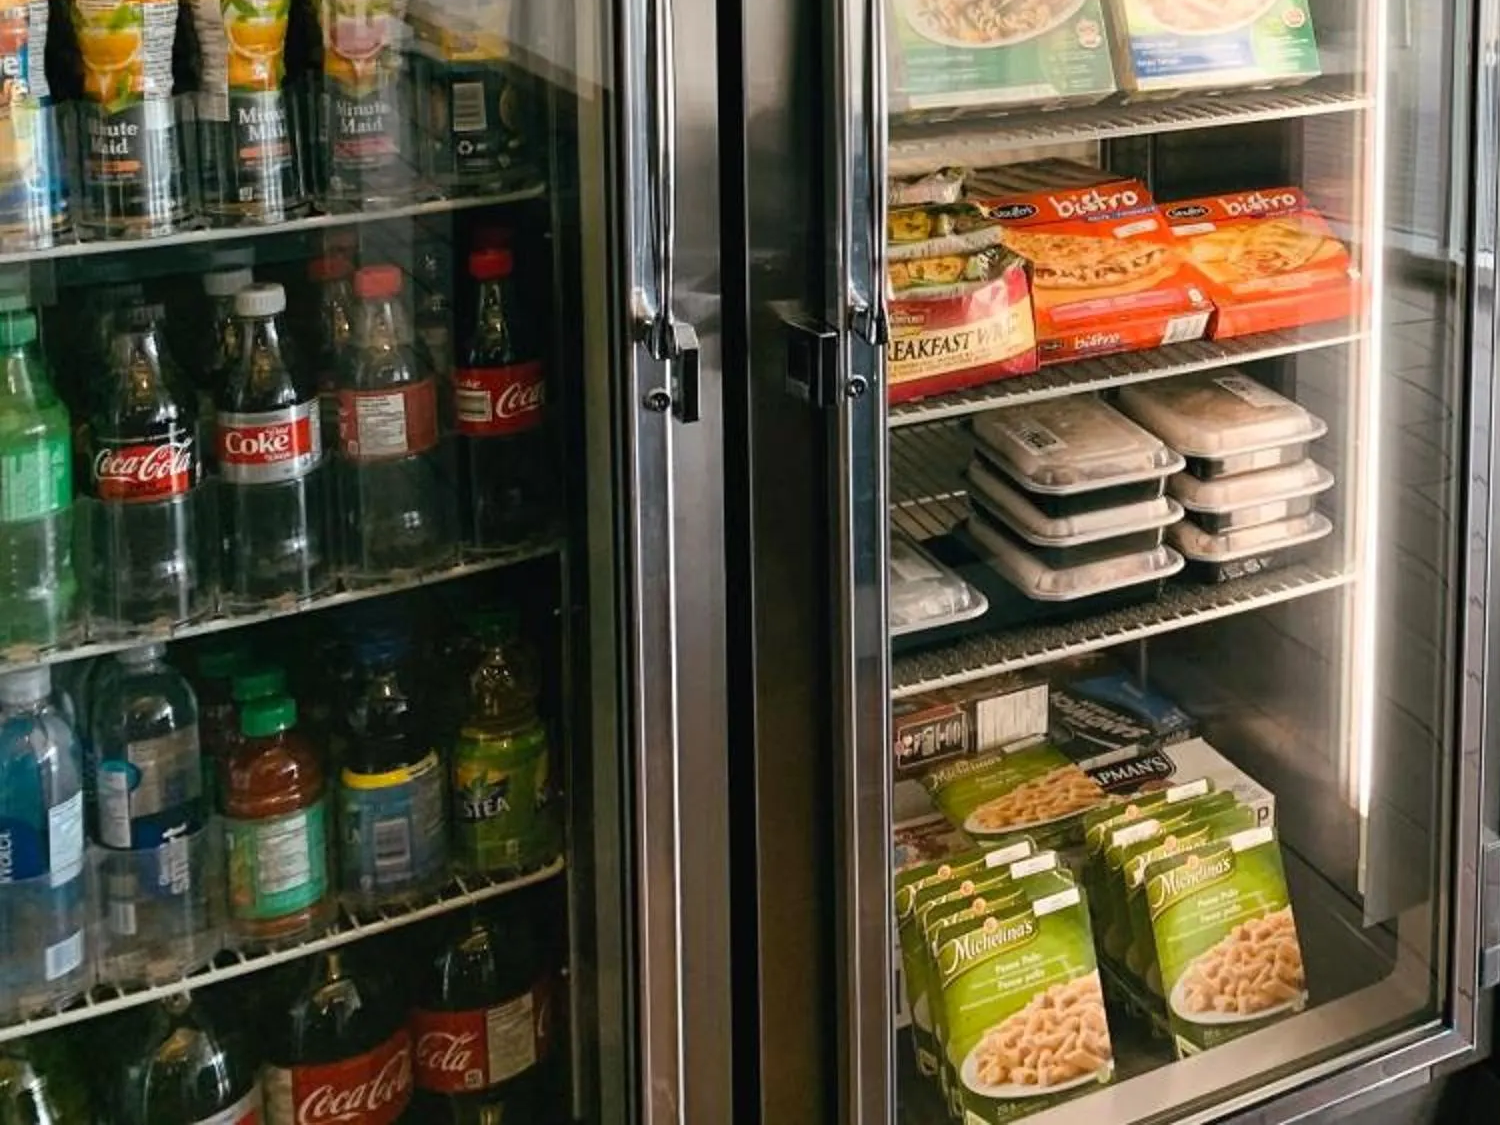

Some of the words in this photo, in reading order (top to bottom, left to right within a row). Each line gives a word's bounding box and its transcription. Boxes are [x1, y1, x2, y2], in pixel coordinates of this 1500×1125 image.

[1048, 189, 1138, 218] bistro
[1219, 192, 1297, 216] bistro
[887, 331, 974, 361] REAKFAST
[225, 431, 289, 455] Coke
[95, 437, 193, 482] Coca-Cola
[1098, 755, 1169, 786] PMAN'S
[1152, 858, 1232, 908] Michelina's
[944, 920, 1033, 975] Michelina's
